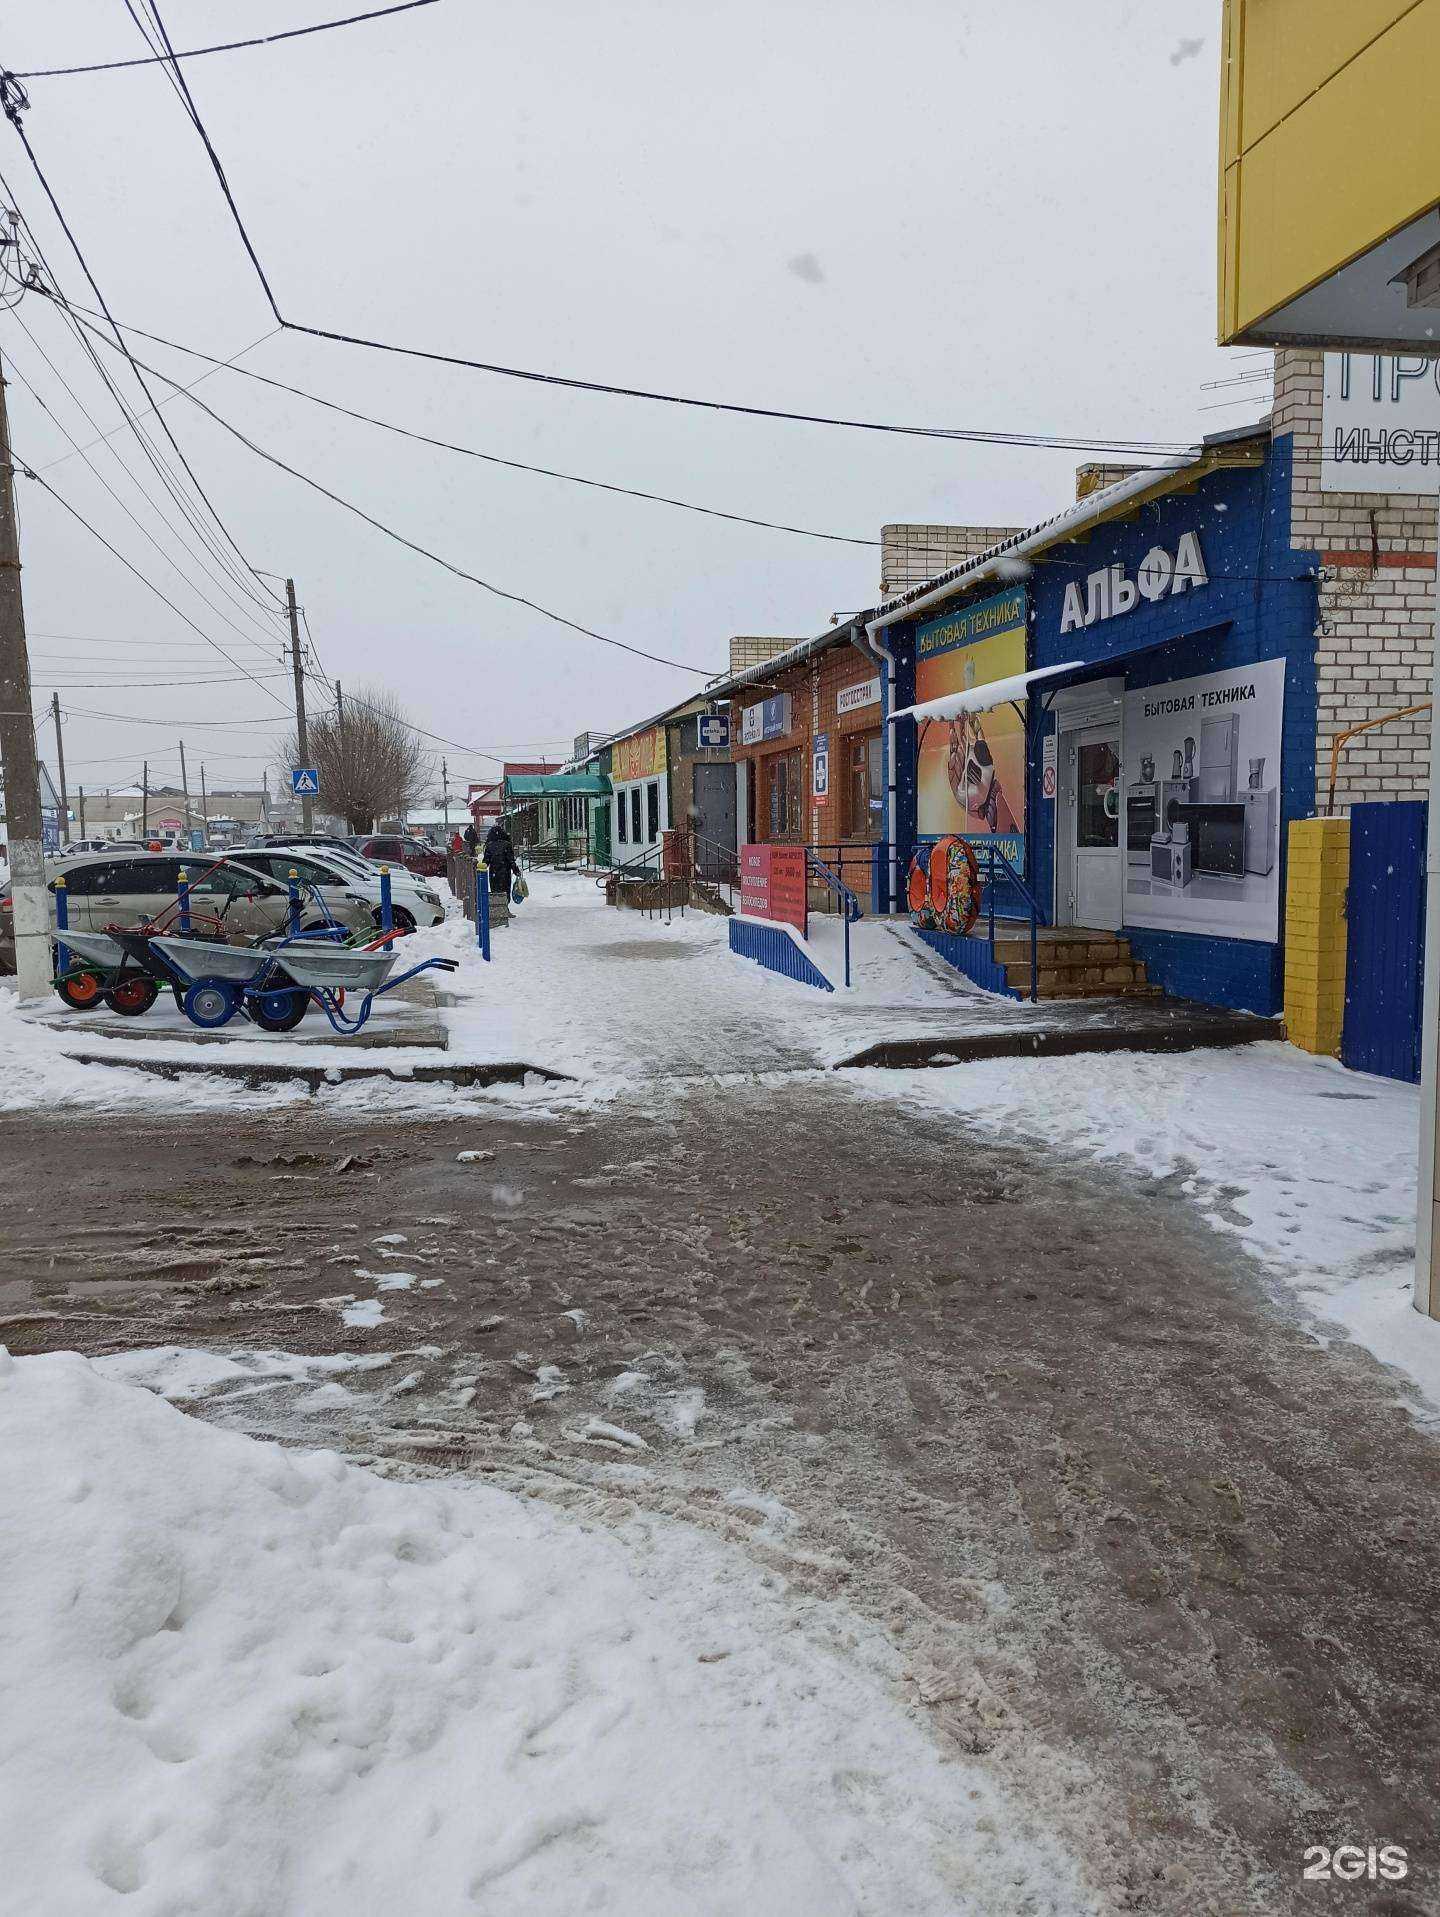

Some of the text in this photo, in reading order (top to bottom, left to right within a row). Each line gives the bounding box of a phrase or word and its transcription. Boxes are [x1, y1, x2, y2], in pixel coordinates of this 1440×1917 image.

[1341, 353, 1440, 401] ПР
[1334, 427, 1440, 465] ИНСТ
[1060, 530, 1209, 634] АЛЬФА
[920, 601, 1020, 654] БЫТОВАЯ ТЕХНИКА
[1144, 684, 1256, 717] БЫТОВАЯ ТЕХНИКА
